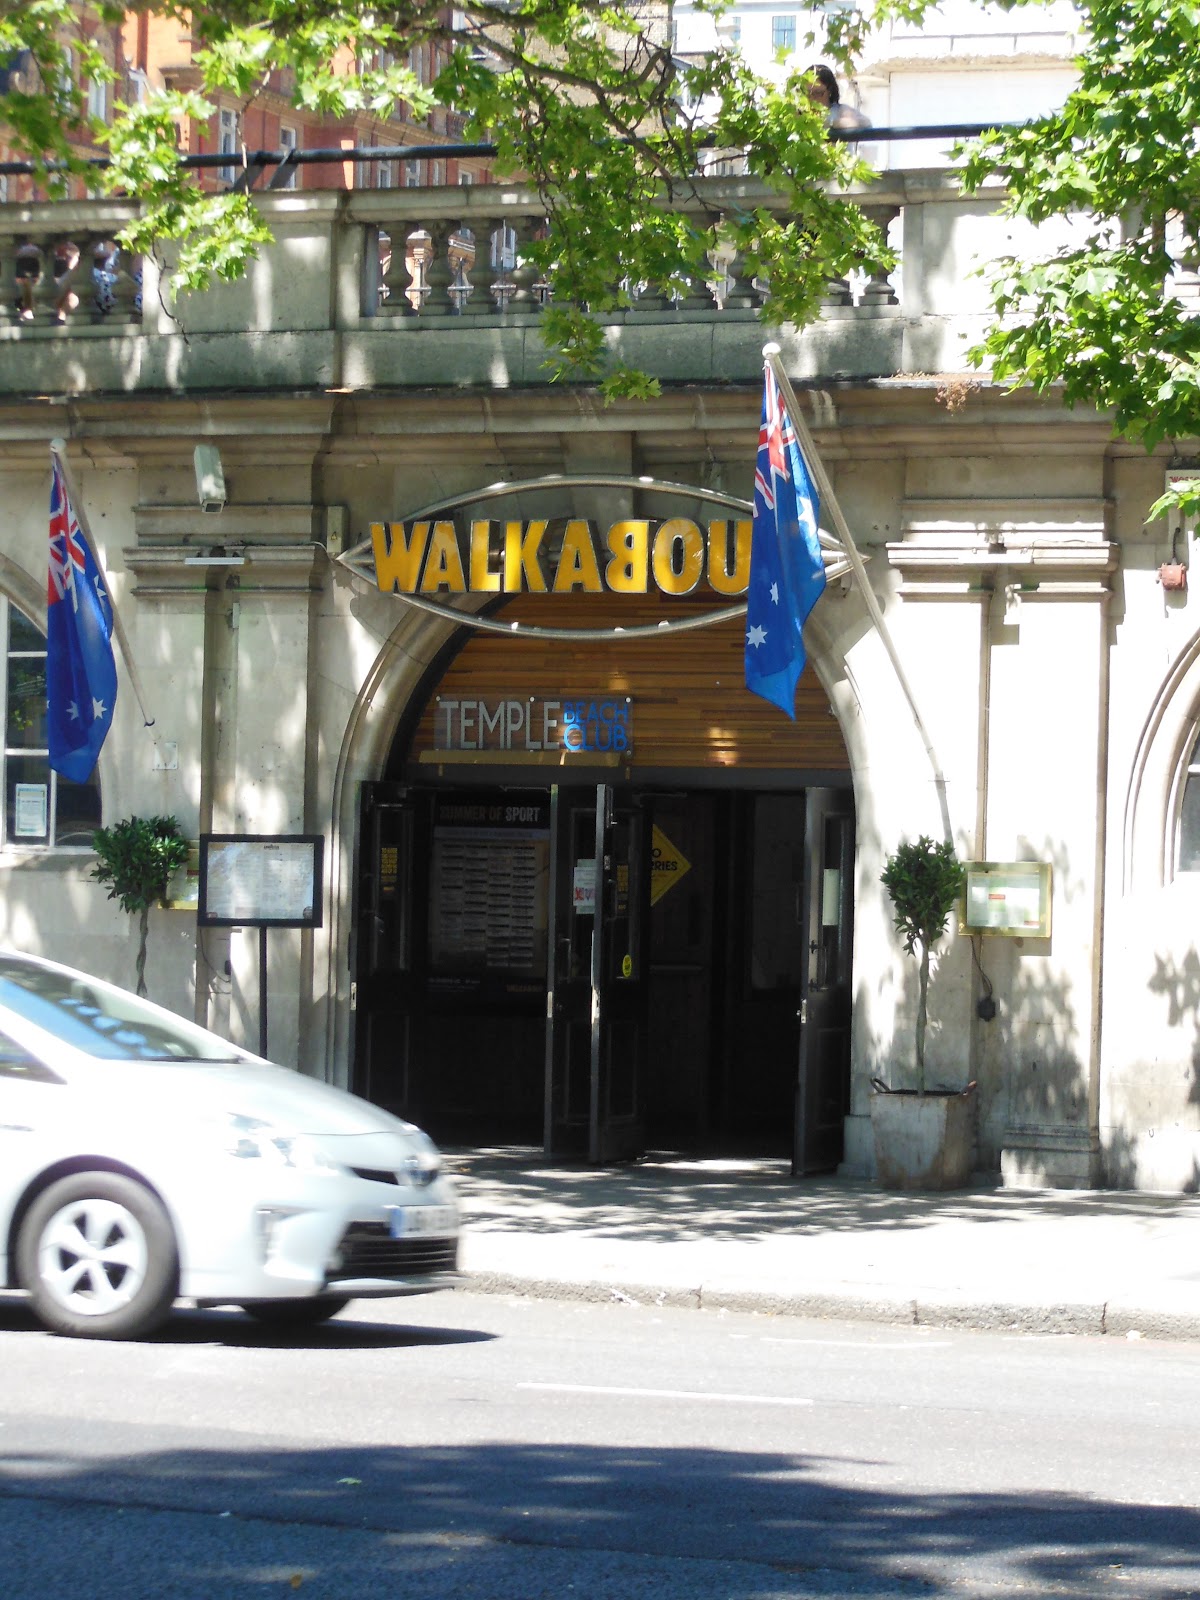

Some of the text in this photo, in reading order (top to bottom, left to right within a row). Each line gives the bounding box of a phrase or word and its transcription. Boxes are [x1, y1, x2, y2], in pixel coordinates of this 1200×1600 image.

[370, 517, 751, 596] WALKABOU
[563, 702, 628, 723] BEACH
[439, 701, 560, 749] TEMPLE
[563, 723, 627, 750] CLUB
[505, 807, 540, 822] SPORT
[651, 848, 662, 858] O
